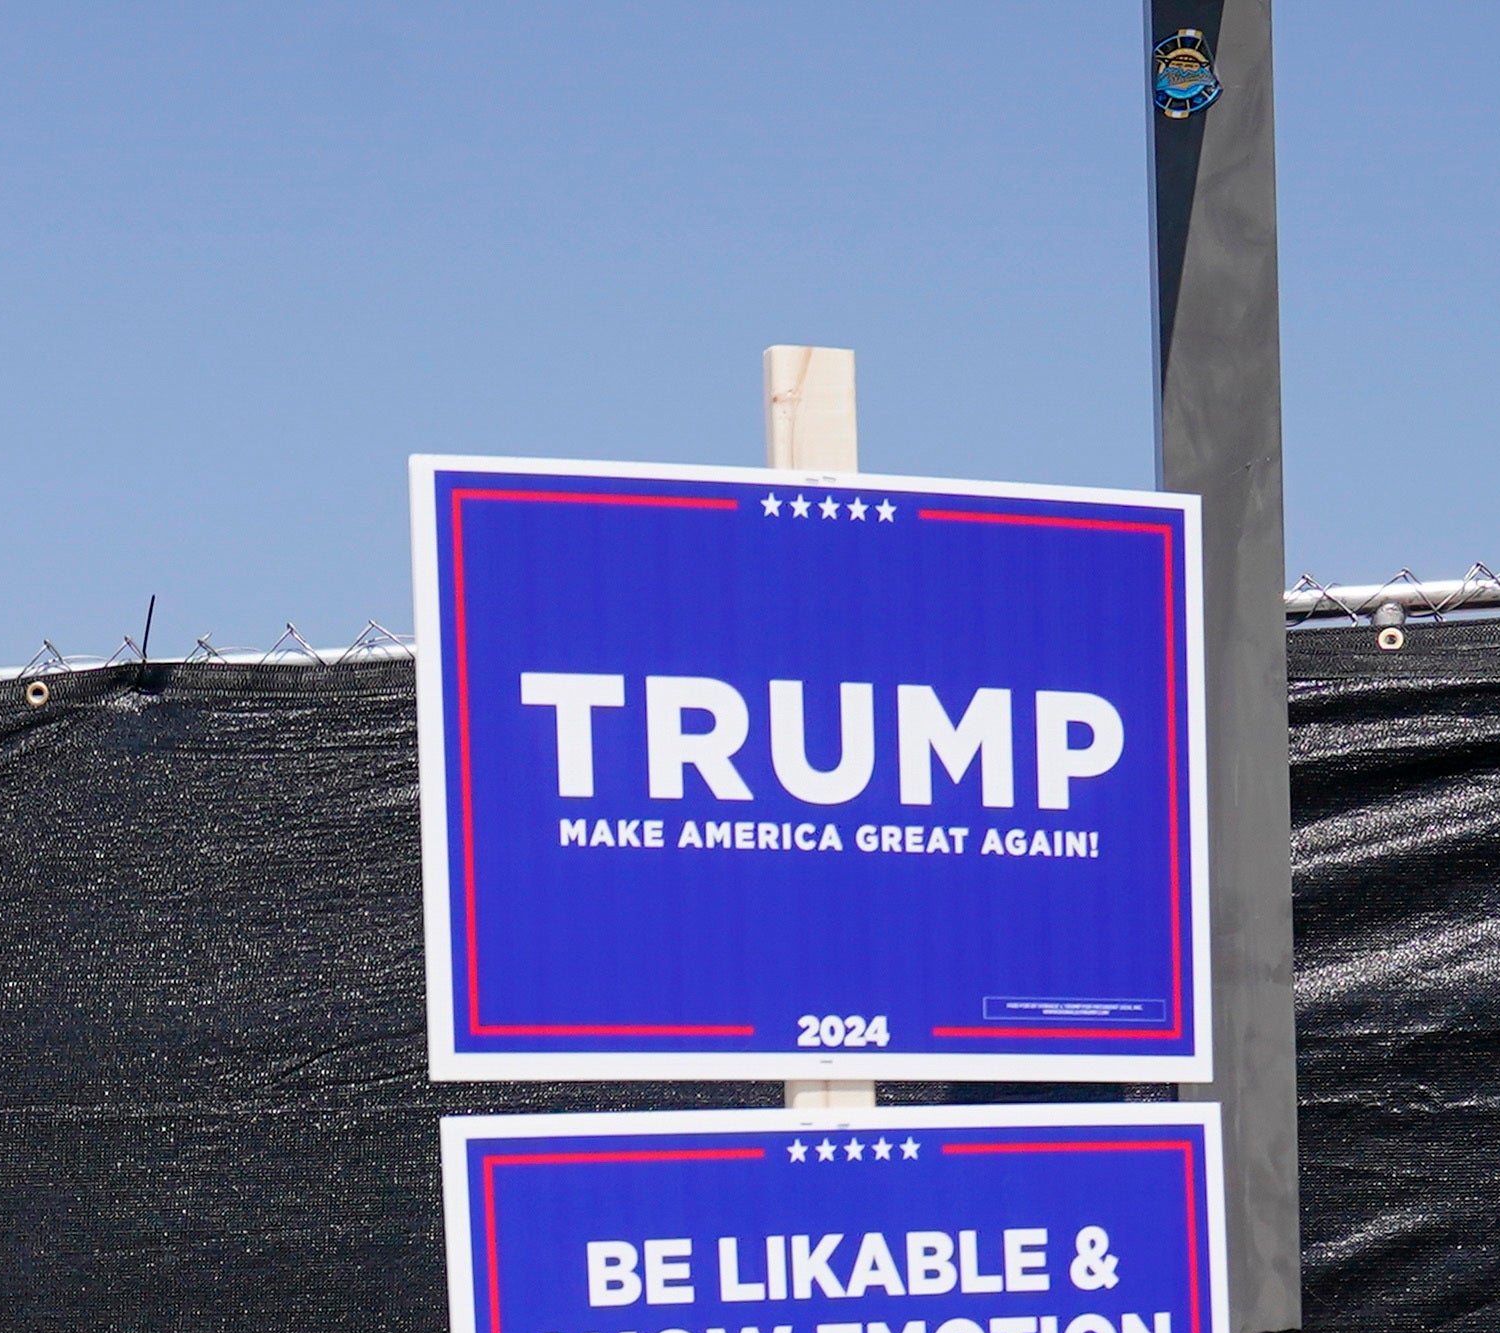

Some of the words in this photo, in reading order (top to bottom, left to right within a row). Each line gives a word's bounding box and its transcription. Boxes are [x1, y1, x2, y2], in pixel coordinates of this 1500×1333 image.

[520, 671, 1125, 810] TRUMP
[559, 818, 665, 848] MAKE
[677, 820, 843, 852] AMERICA
[855, 824, 969, 855] GREAT
[980, 827, 1099, 858] AGAIN!
[797, 1014, 891, 1048] 2024
[586, 1238, 695, 1308] BE
[718, 1227, 1050, 1303] LIKABLE
[1069, 1225, 1120, 1291] &
